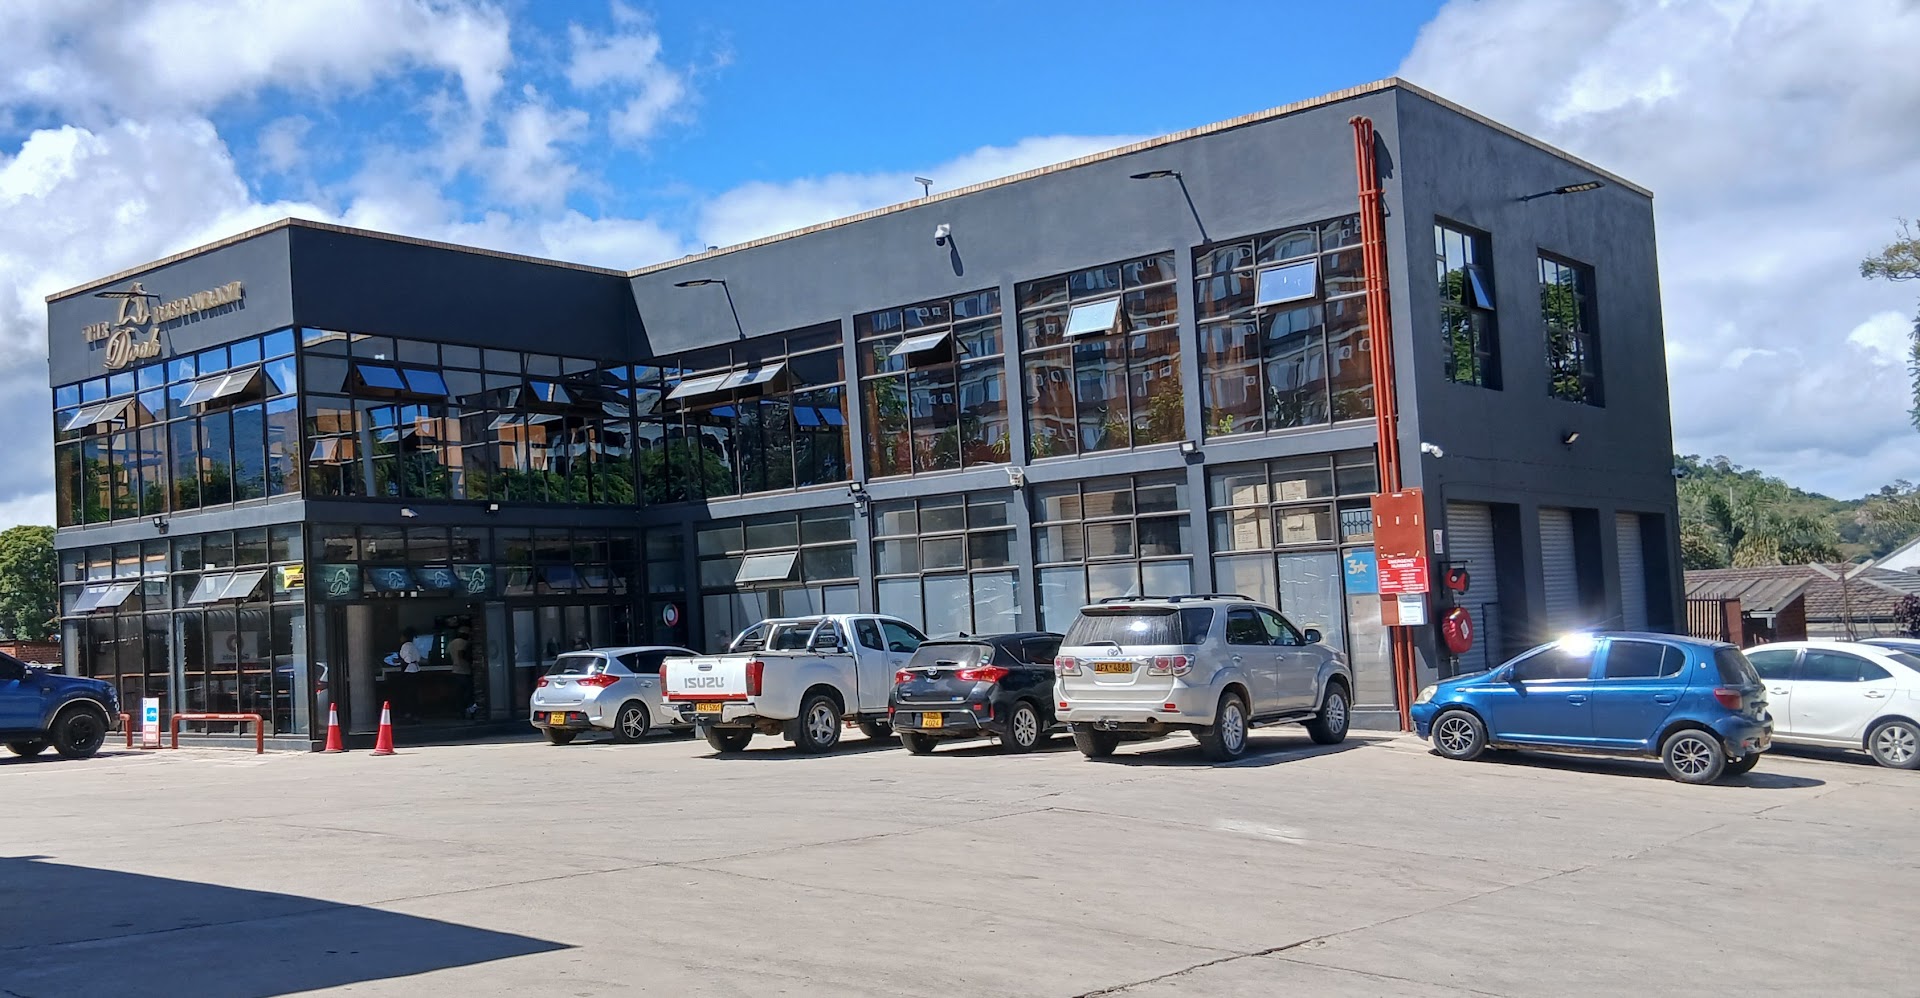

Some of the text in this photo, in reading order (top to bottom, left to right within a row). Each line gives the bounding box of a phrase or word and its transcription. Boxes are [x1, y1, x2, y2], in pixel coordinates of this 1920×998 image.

[153, 282, 243, 324] RESTAURANT
[83, 322, 110, 344] THE
[684, 676, 725, 688] ISUZU
